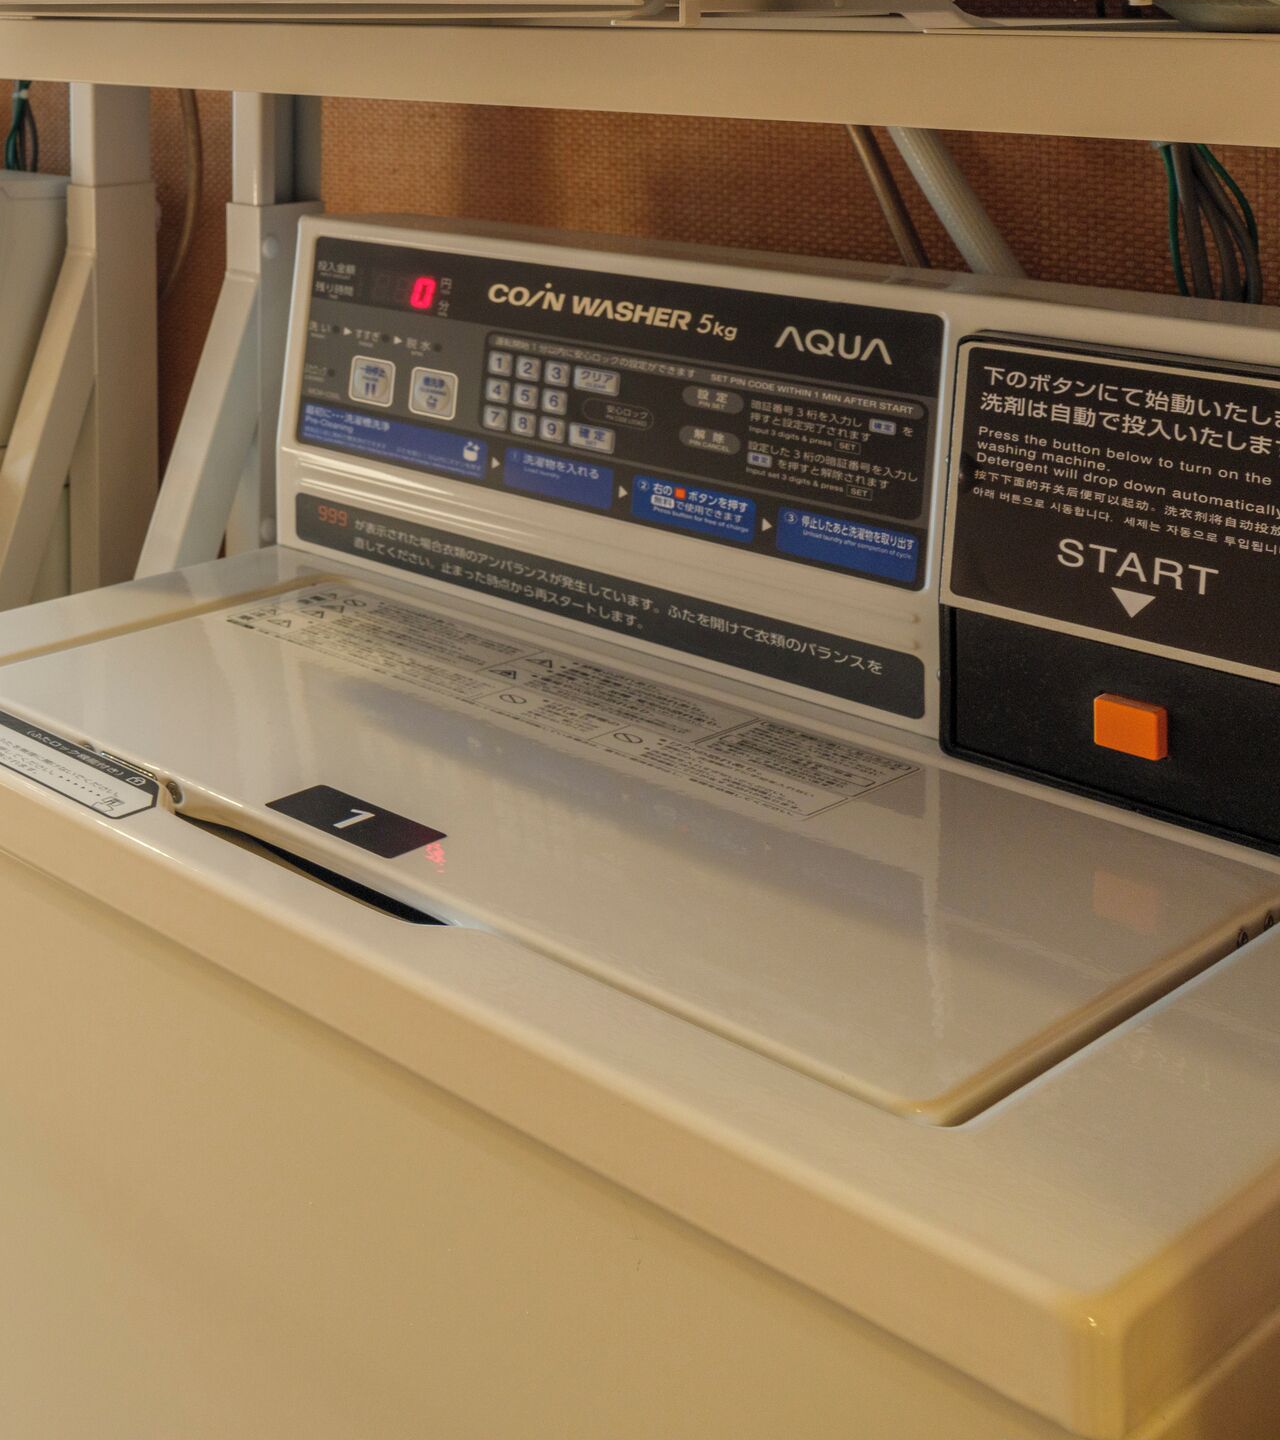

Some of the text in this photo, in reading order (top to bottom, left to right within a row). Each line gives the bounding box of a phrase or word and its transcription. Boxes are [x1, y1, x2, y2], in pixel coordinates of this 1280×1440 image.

[410, 275, 436, 311] 0
[572, 294, 692, 332] WASHER
[774, 323, 894, 366] AQUA
[579, 369, 613, 385] クリア
[710, 373, 914, 416] SET PIN CODE WITHIN 1 MIN AFTER START
[983, 365, 1280, 427] 下のボタンにて始動いたし
[979, 391, 1280, 457] 洗剤は自動で投入いたしま
[976, 452, 1048, 476] Detergent
[1053, 465, 1078, 480] will
[1082, 471, 1117, 490] drop
[1123, 478, 1165, 496] down
[977, 439, 1110, 472] washing machine.
[978, 425, 1271, 487] Press the button below to turn on the
[317, 505, 348, 528] 999
[687, 489, 749, 514] ボタンを押す
[972, 486, 1280, 557] 아래 버튼으로 시동합니다. 세제는 자동으로 투입됩니
[1057, 536, 1219, 598] START
[333, 809, 376, 830] 1
